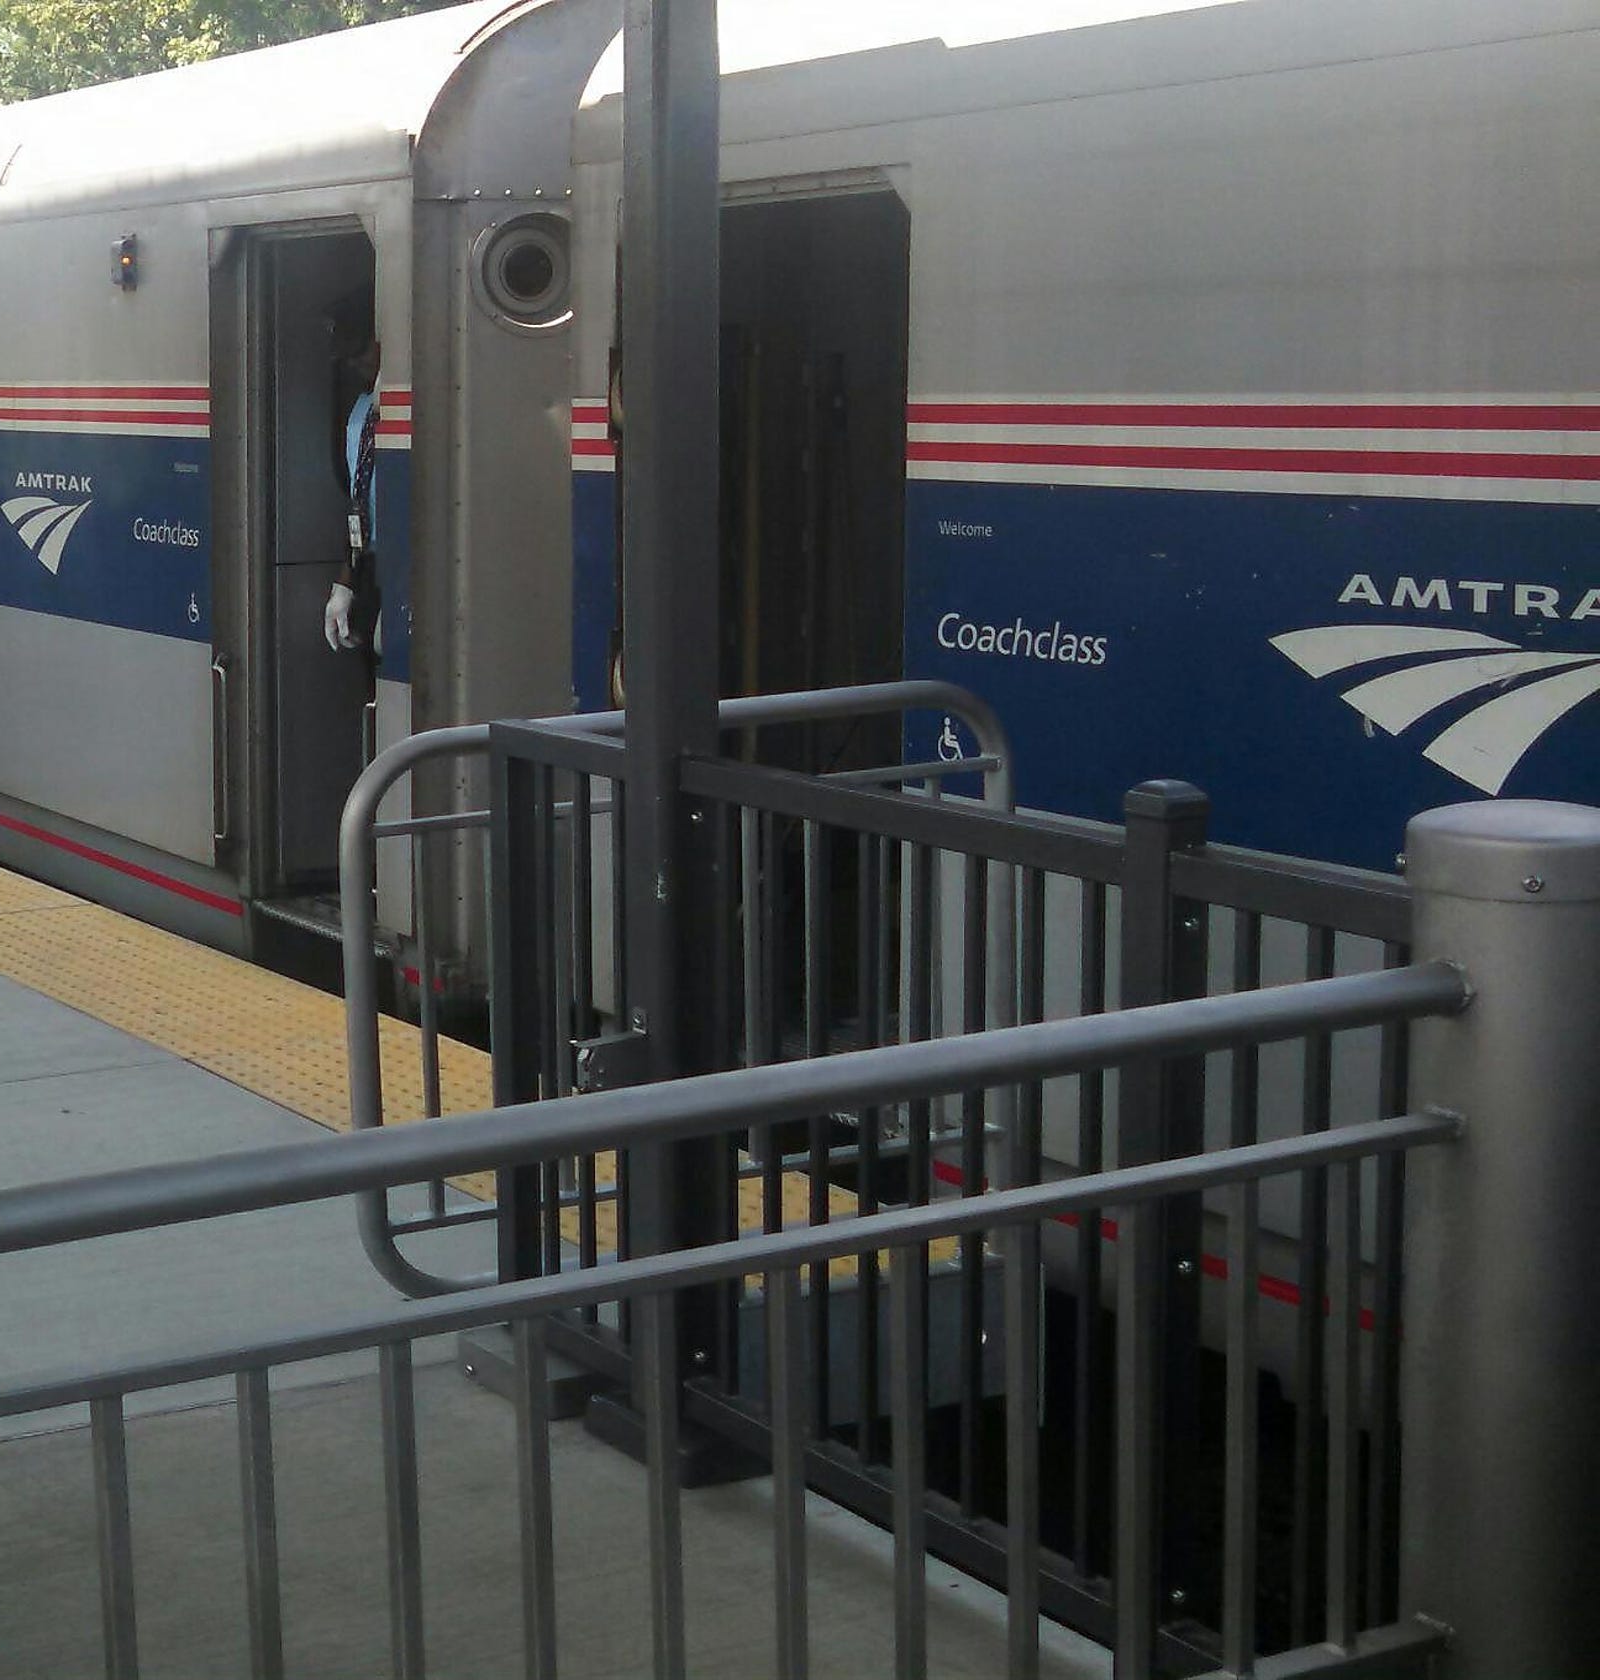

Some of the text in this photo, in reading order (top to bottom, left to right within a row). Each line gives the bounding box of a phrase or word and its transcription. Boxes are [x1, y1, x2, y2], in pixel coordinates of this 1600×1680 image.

[15, 472, 93, 493] AMTRAK
[133, 517, 200, 548] Coachclass
[938, 520, 993, 537] Welcome
[937, 612, 1108, 665] Coachclass
